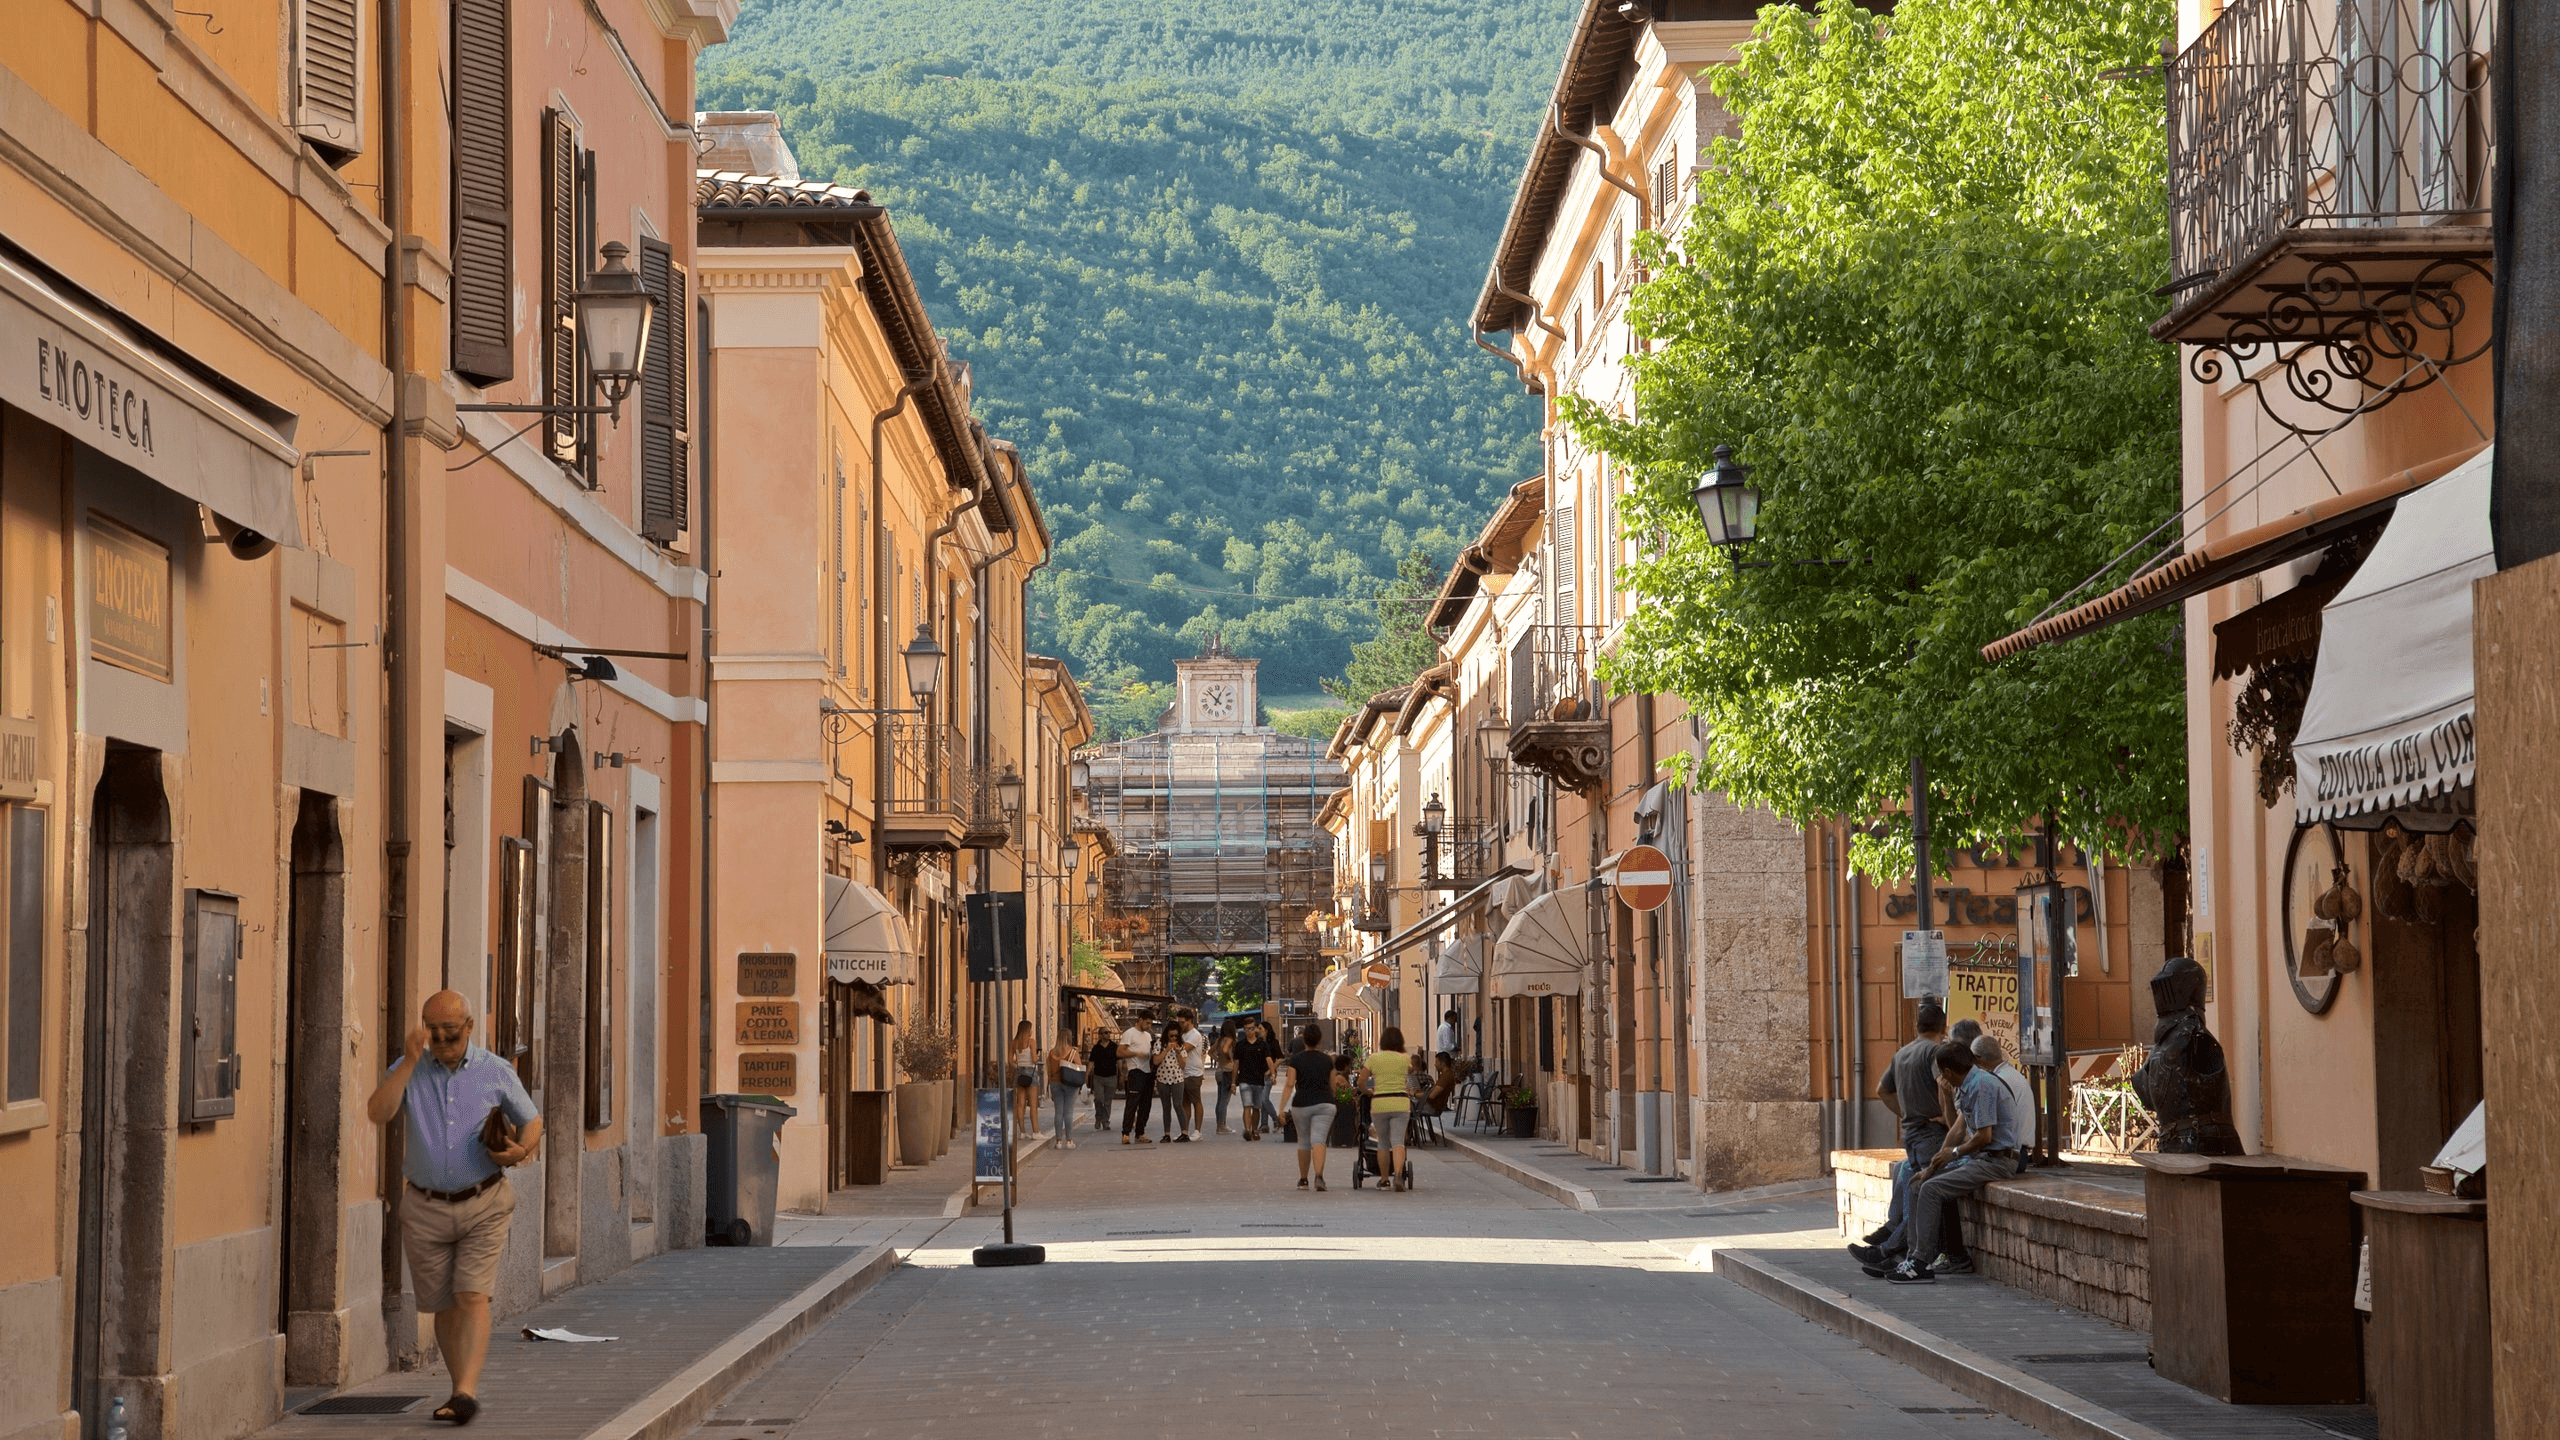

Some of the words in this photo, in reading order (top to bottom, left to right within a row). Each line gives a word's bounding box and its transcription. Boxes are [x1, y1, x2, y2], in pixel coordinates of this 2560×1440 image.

[38, 337, 154, 458] ENOTECA
[96, 545, 160, 627] ENOTECA
[2, 732, 36, 783] MENU
[2318, 743, 2386, 802] EDICOLA
[2391, 732, 2427, 785] DEL
[2431, 713, 2475, 773] COR
[740, 955, 794, 966] PROSCIUTTO
[829, 959, 887, 971] NTICCHIE
[744, 969, 753, 979] DI
[756, 968, 788, 979] NORCIA
[751, 1005, 783, 1016] PANE
[1335, 1008, 1361, 1016] TARTUFI
[746, 1018, 788, 1028] COTTO
[741, 1030, 749, 1040] A
[753, 1029, 794, 1040] LEGNA
[743, 1060, 790, 1072] TARTUFI
[741, 1076, 792, 1088] FRESCHI
